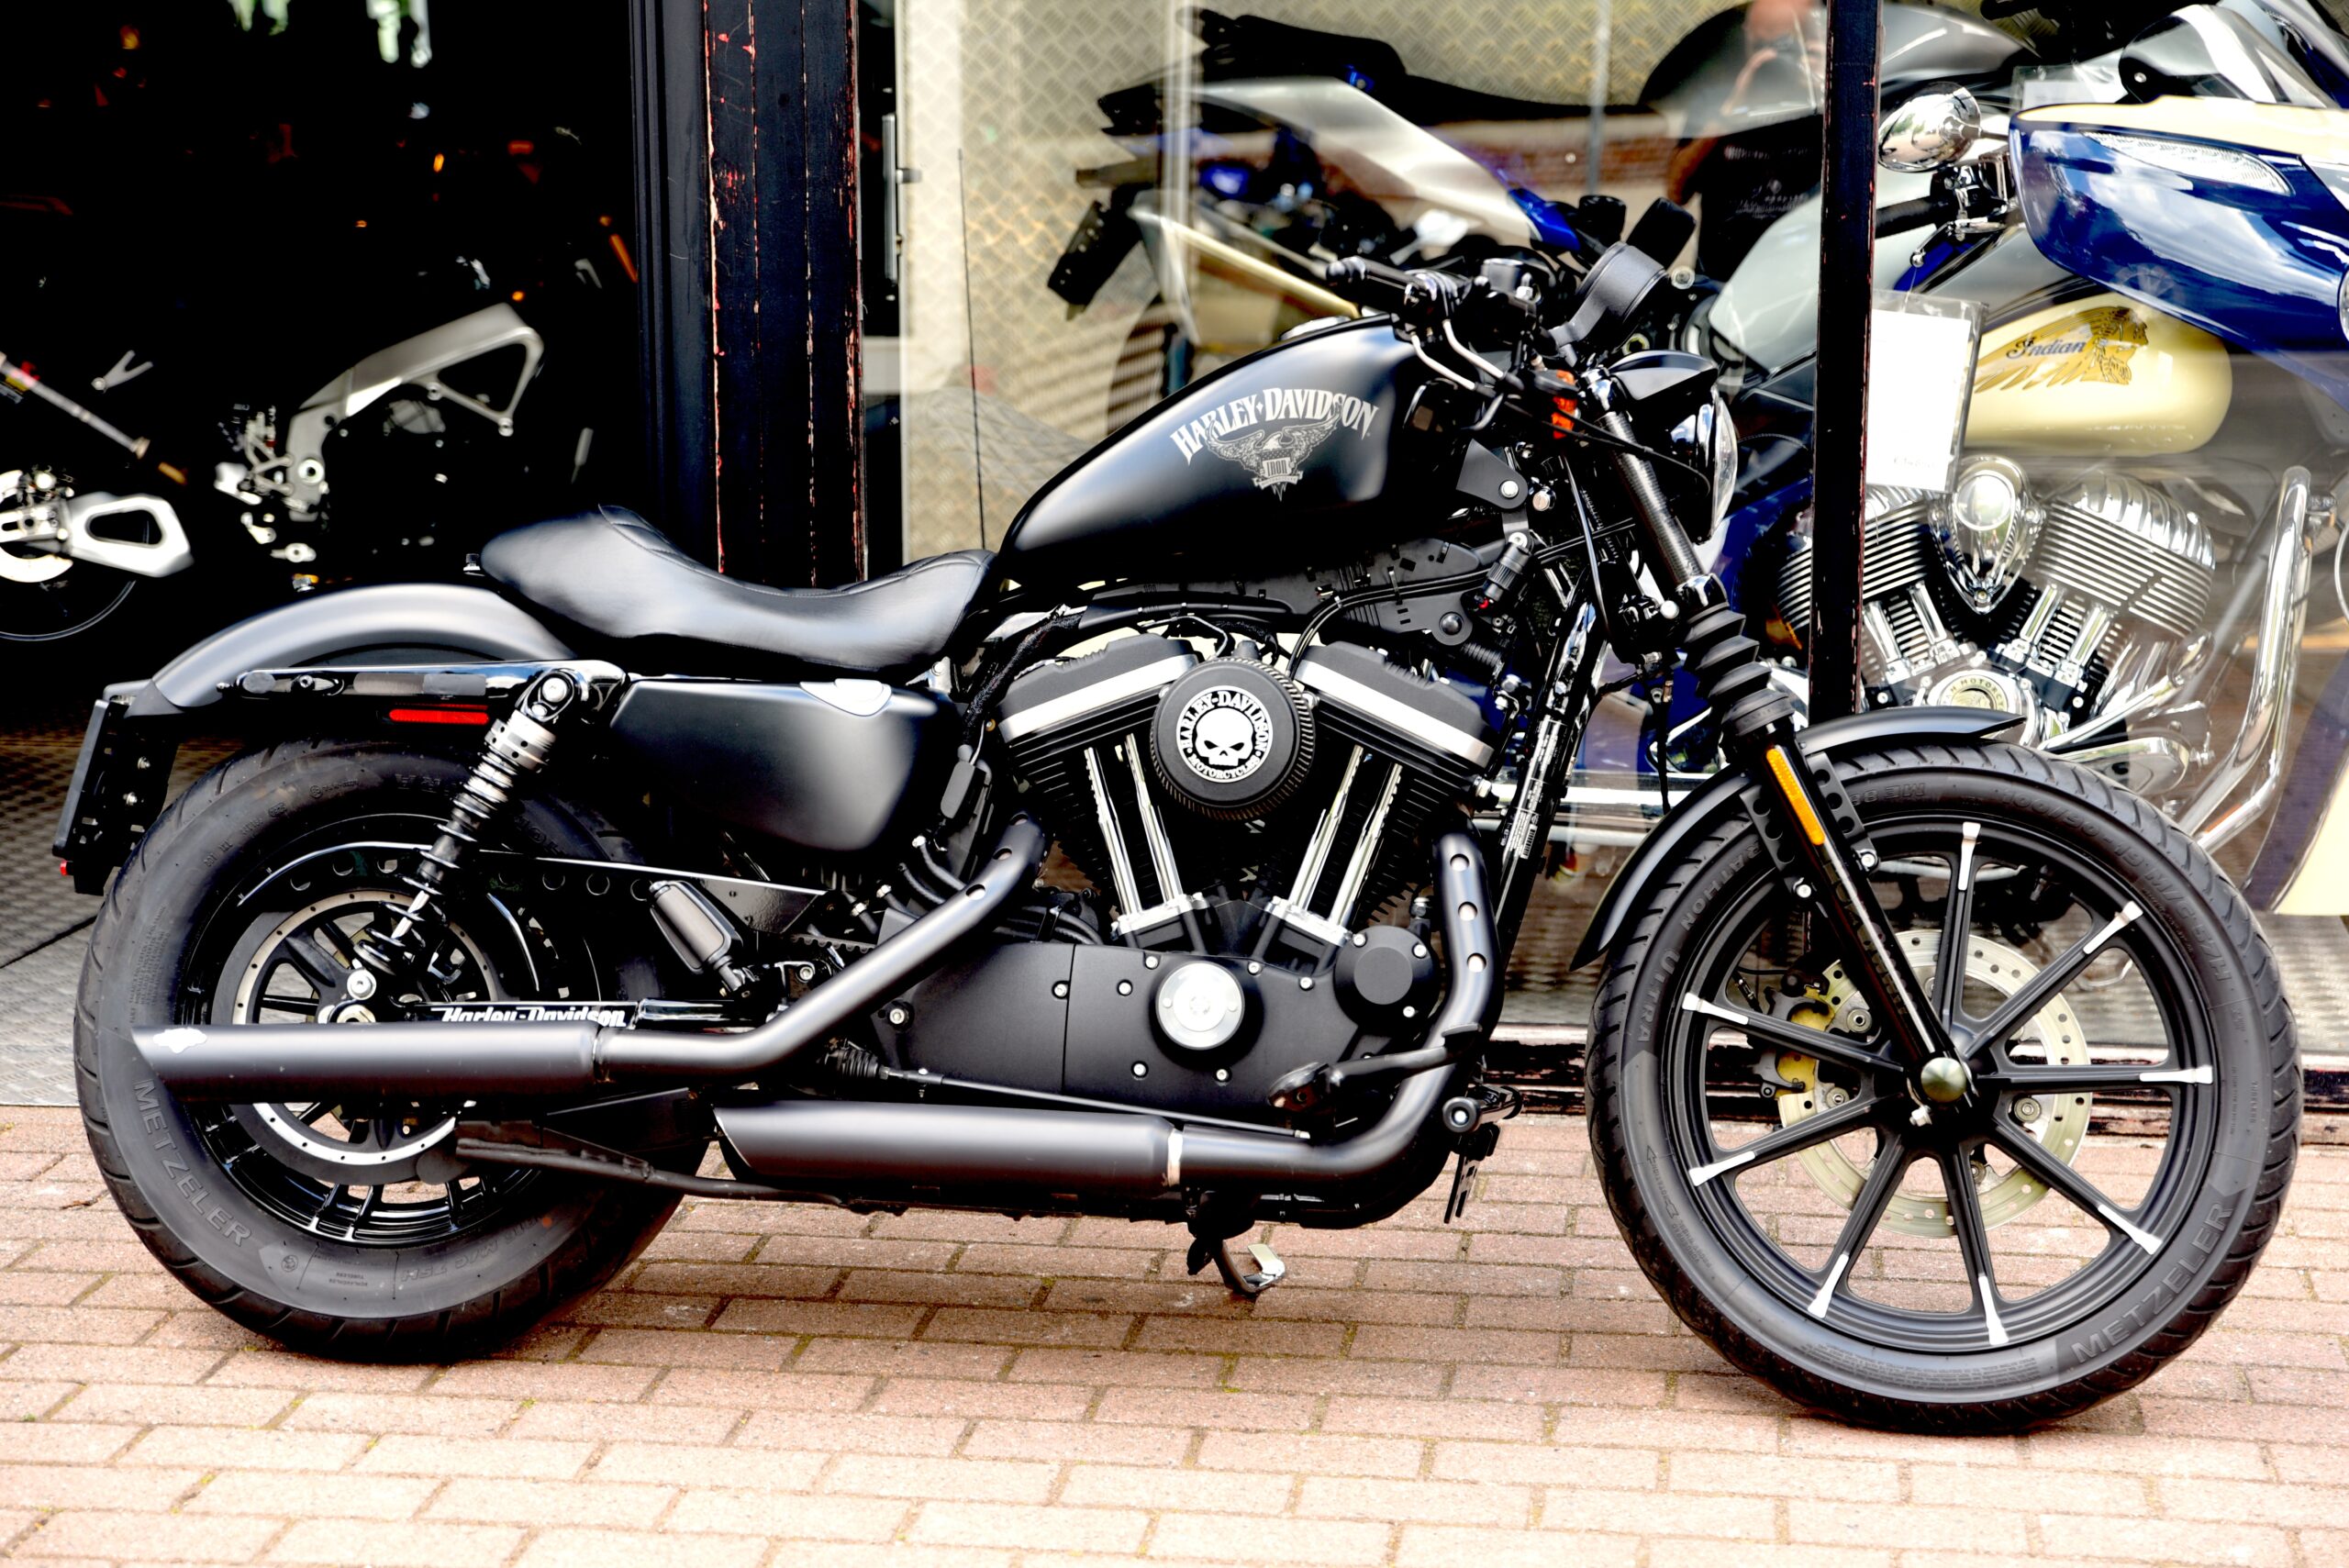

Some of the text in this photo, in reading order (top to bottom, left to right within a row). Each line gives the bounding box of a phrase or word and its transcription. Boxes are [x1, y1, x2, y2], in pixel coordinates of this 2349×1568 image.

[2006, 337, 2086, 359] Indian
[134, 1078, 252, 1248] METZELER
[2070, 1202, 2233, 1364] METZELER
